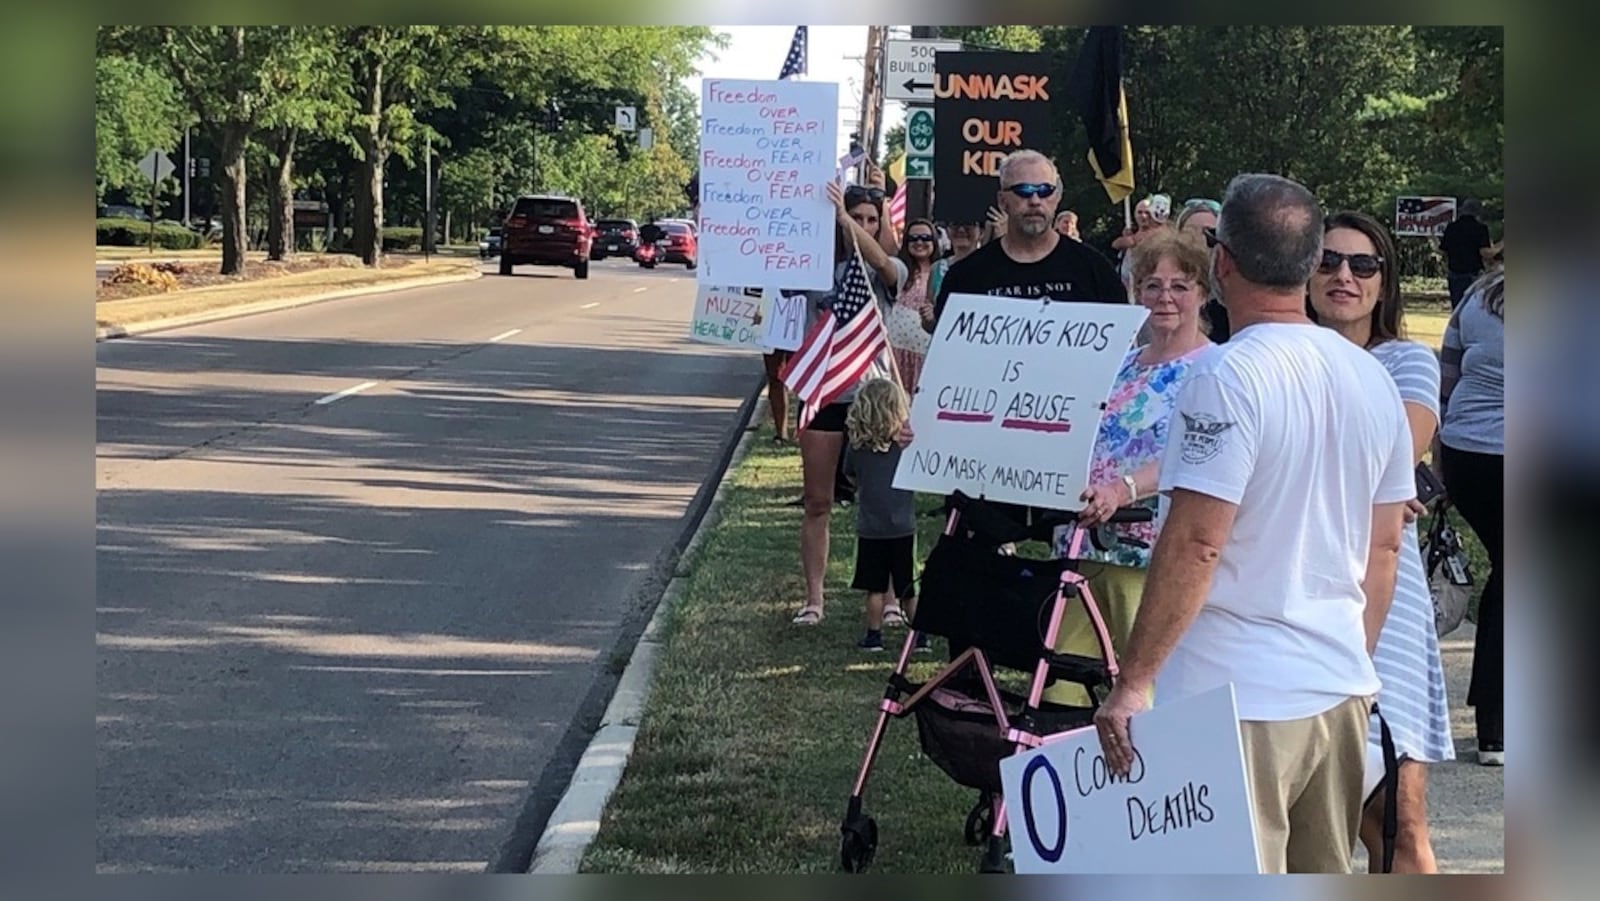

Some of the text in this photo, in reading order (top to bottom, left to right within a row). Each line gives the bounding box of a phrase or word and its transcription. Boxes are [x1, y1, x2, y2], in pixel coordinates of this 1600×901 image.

[911, 46, 936, 58] 500
[709, 81, 777, 103] Freedom
[935, 73, 1050, 100] UNMASK
[760, 106, 799, 119] OVER
[705, 118, 825, 136] Freedom FEAR!
[962, 118, 1023, 147] OUR
[756, 137, 803, 150] OVER
[703, 150, 822, 169] Freedom FEAR!
[963, 149, 1007, 177] KID
[747, 168, 799, 183] OVER
[703, 182, 823, 204] Freedom FEAR!
[745, 206, 801, 221] OVER
[700, 217, 821, 238] Freedom FEAR!
[740, 238, 795, 256] OVER
[764, 254, 822, 271] FEAR!
[1027, 285, 1041, 296] IS
[1045, 282, 1073, 293] NOT
[705, 296, 761, 321] MUZZ
[945, 311, 1115, 352] MASKING KIDS
[1002, 359, 1024, 382] IS
[937, 385, 1076, 422] CHILD ABUSE
[911, 450, 1069, 496] NO MASK MANDATE
[1126, 781, 1215, 841] DEATHS
